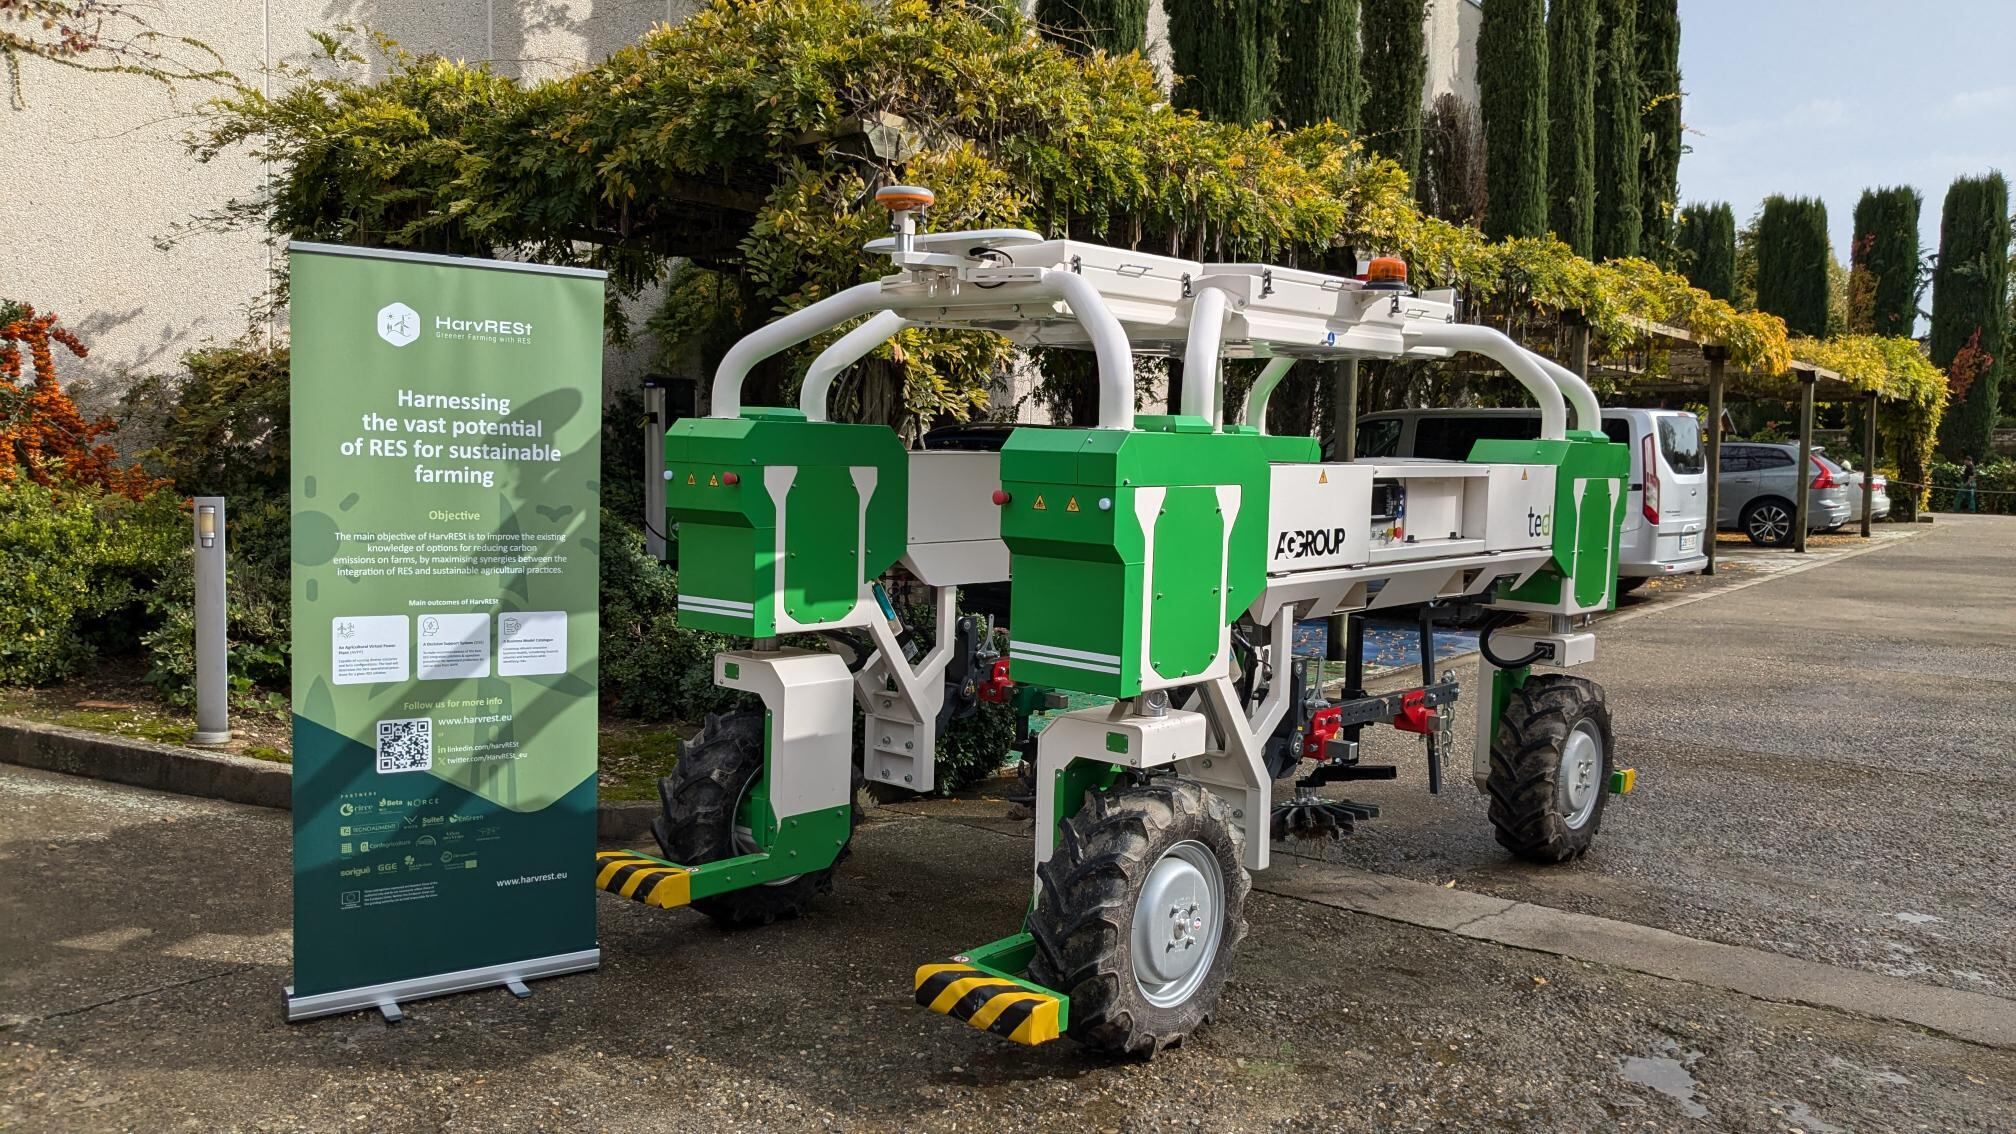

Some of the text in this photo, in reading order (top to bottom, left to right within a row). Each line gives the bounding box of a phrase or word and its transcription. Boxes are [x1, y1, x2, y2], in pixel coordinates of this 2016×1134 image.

[435, 315, 533, 336] HarvRESt
[435, 331, 532, 345] Greener Farming with RES
[398, 389, 511, 416] Harnessing
[362, 412, 542, 438] the vast potential
[340, 437, 561, 462] of RES for sustainable
[414, 464, 495, 488] farming
[428, 510, 480, 522] Objective
[1527, 504, 1551, 538] ted
[334, 531, 567, 543] The main objective of HarvRESt is to improve the existing
[367, 543, 538, 554] knowledge of options for reducing carbon
[333, 555, 568, 565] emissions on farms, by maximising synergies between the
[337, 565, 564, 578] integration of RES and sustainable agricultural practices.
[408, 599, 426, 607] Main
[403, 697, 503, 711] Follow us for more info
[438, 713, 513, 726] www.harvrest.eu
[447, 741, 519, 753] linkedin.com/harvRESt
[447, 752, 528, 765] twitter.com/HarvRESt_eu
[377, 862, 398, 872] GGE
[496, 872, 568, 887] www.harvrest.eu
